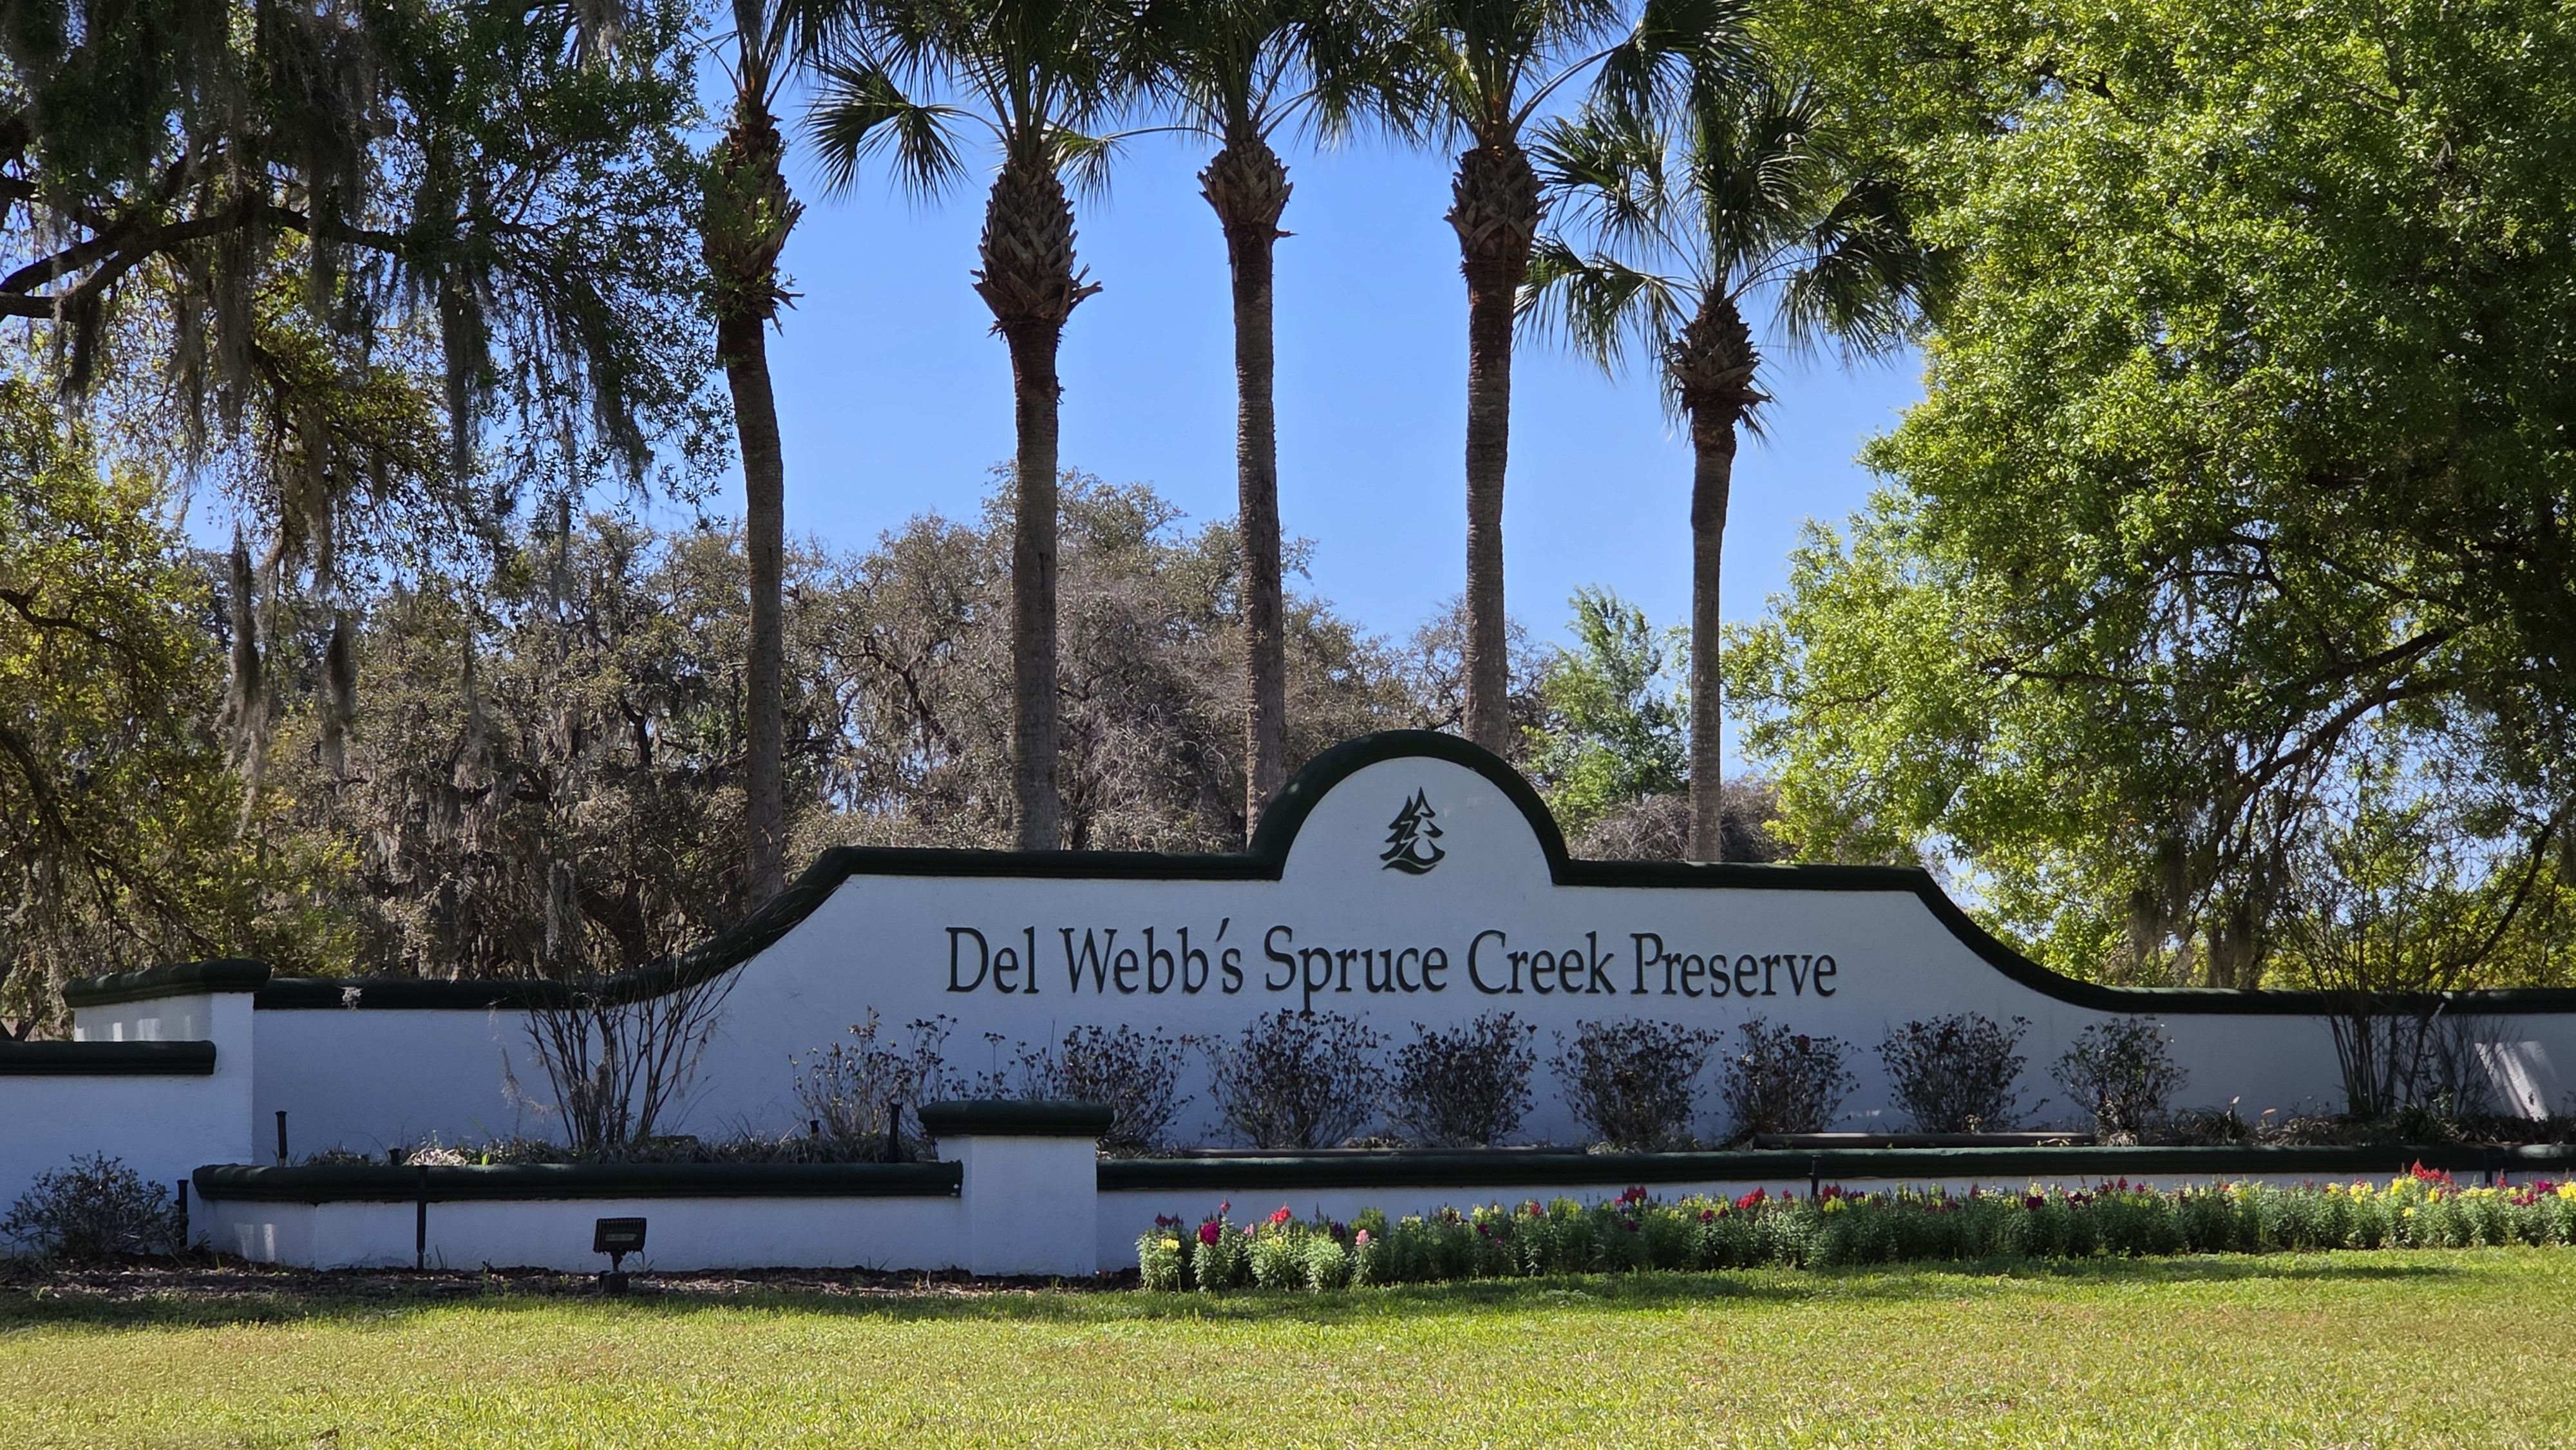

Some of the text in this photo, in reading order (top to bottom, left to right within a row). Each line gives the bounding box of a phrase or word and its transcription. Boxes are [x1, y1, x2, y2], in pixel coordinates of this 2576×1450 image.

[945, 917, 1837, 1016] Del Webb's Spruce Creek Preserve
